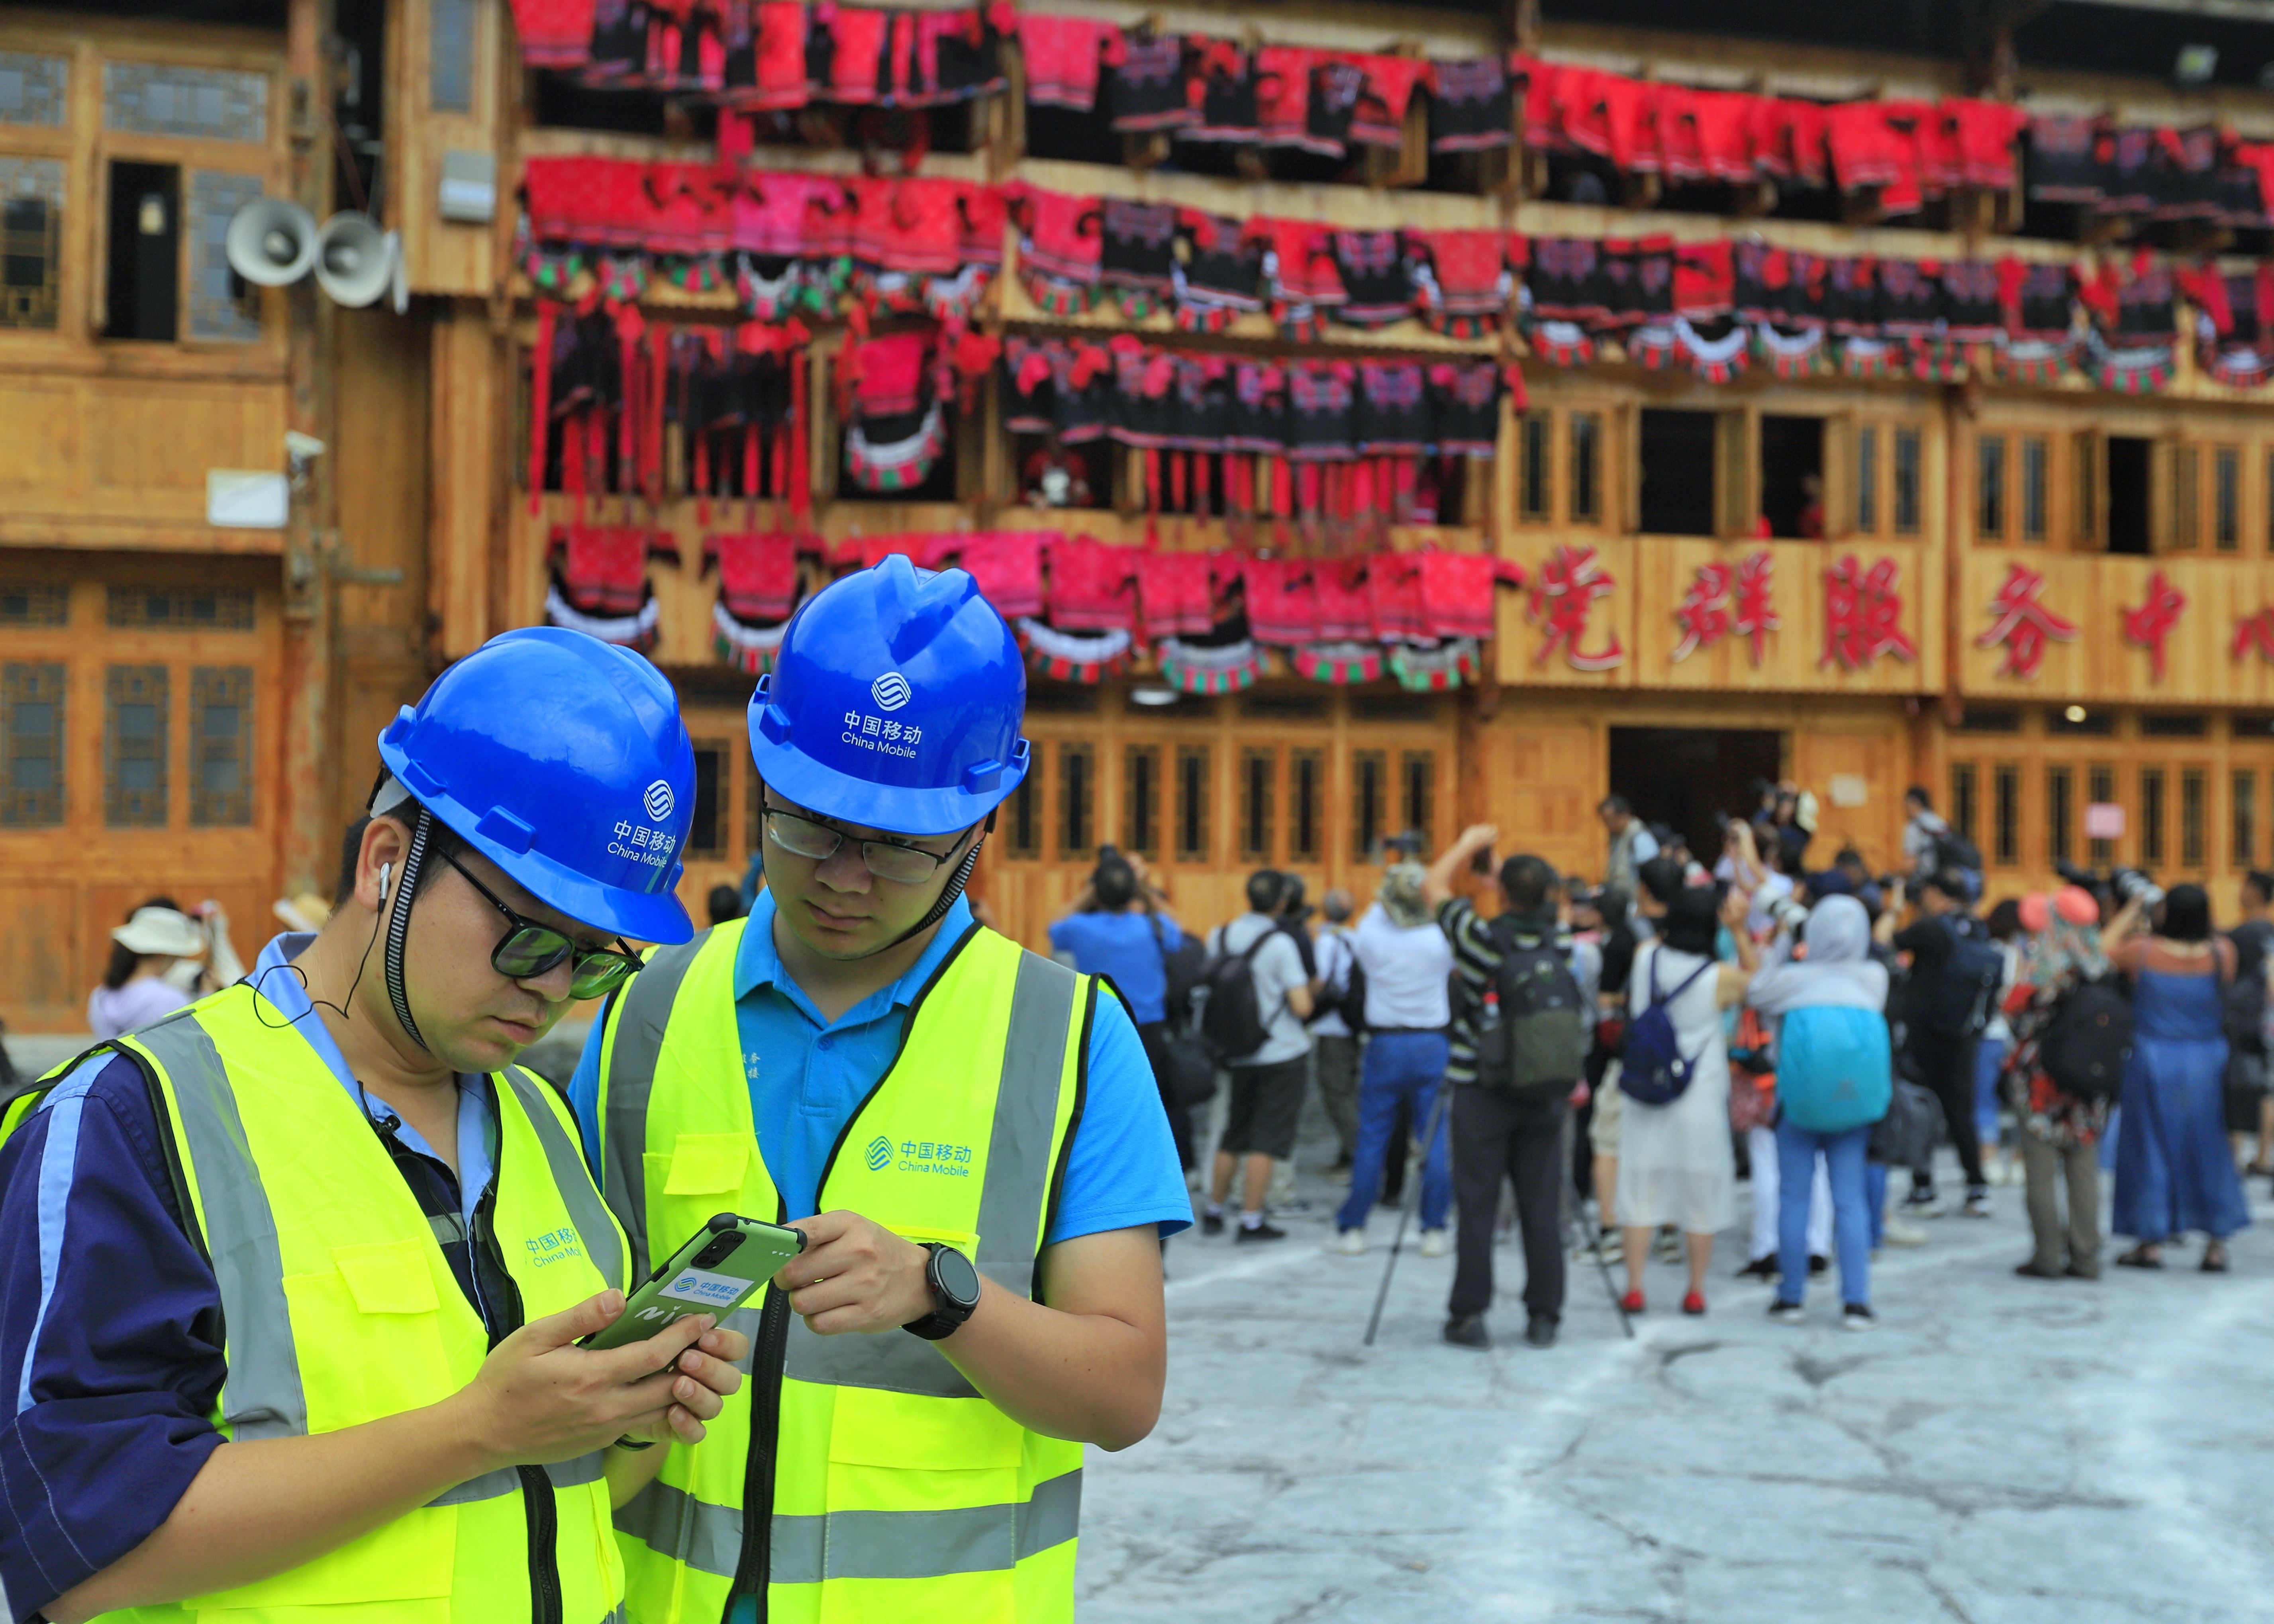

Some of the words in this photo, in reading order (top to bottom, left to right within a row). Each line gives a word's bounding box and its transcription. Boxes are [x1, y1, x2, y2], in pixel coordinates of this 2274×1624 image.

[844, 710, 922, 745] 中国移动
[841, 732, 874, 750] China
[877, 741, 916, 759] Mobile
[614, 820, 676, 853] 中国移动
[607, 841, 640, 861] China
[640, 852, 667, 868] Mobile
[900, 1141, 972, 1163] 中国移动
[898, 1160, 929, 1172] China
[932, 1163, 969, 1177] Mobile
[533, 1251, 565, 1267] China
[700, 1282, 739, 1295] 中国移动
